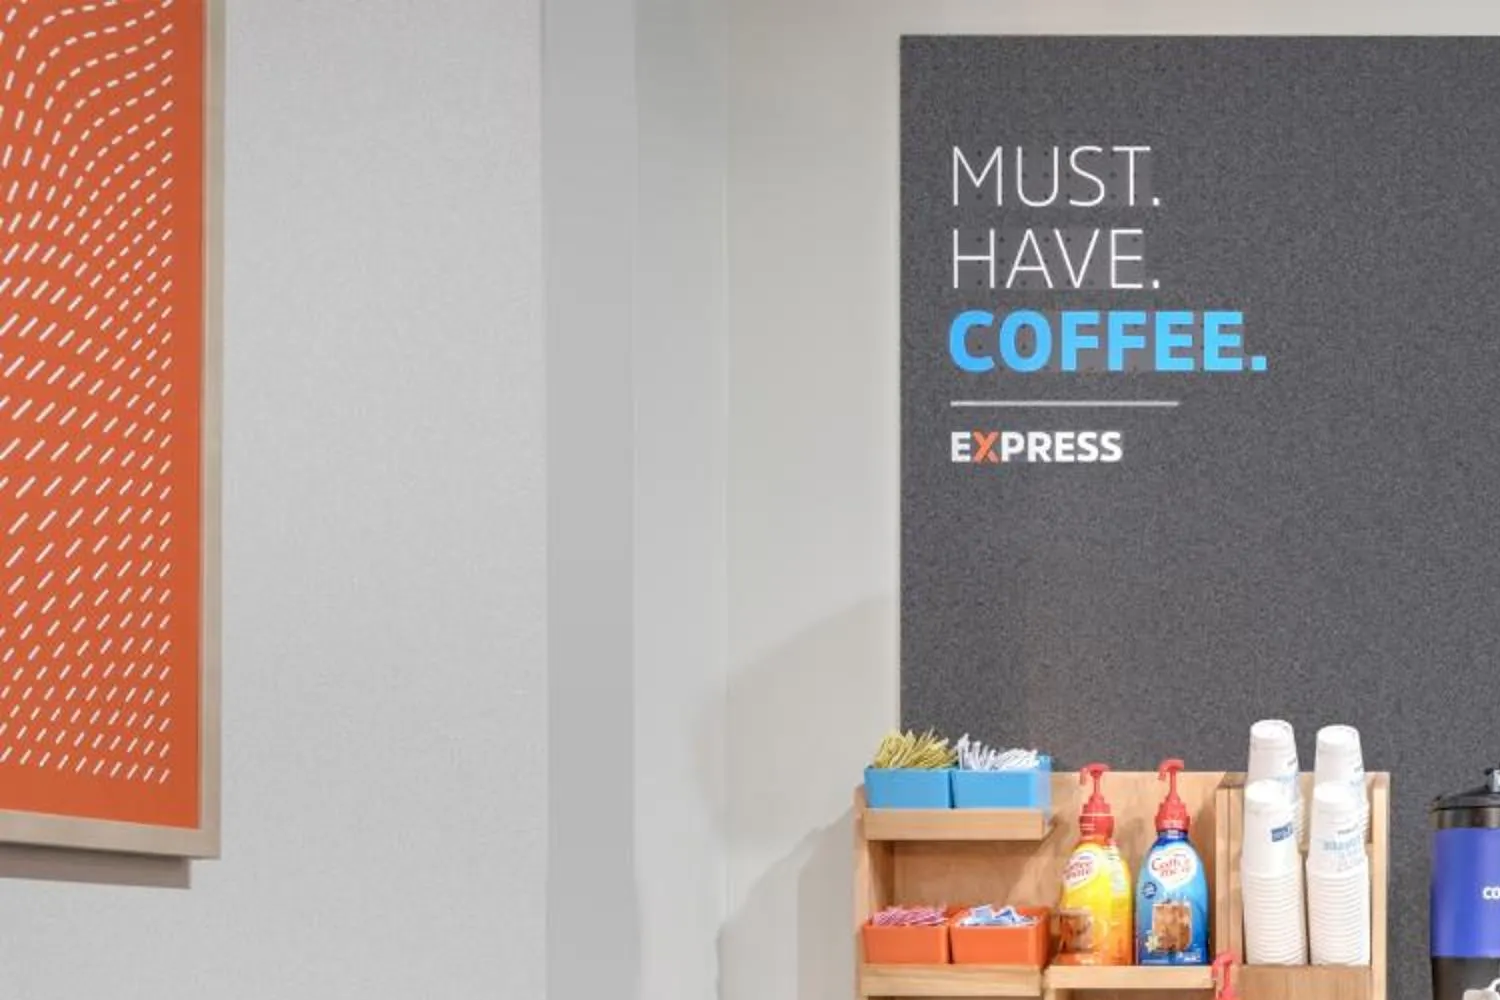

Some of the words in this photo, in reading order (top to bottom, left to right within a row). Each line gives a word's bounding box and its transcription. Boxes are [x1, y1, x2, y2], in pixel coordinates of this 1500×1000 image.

[953, 146, 1160, 207] MUST.
[953, 229, 1160, 289] HAVE.
[949, 310, 1268, 372] COFFEE.
[951, 431, 1123, 463] EXPRESS
